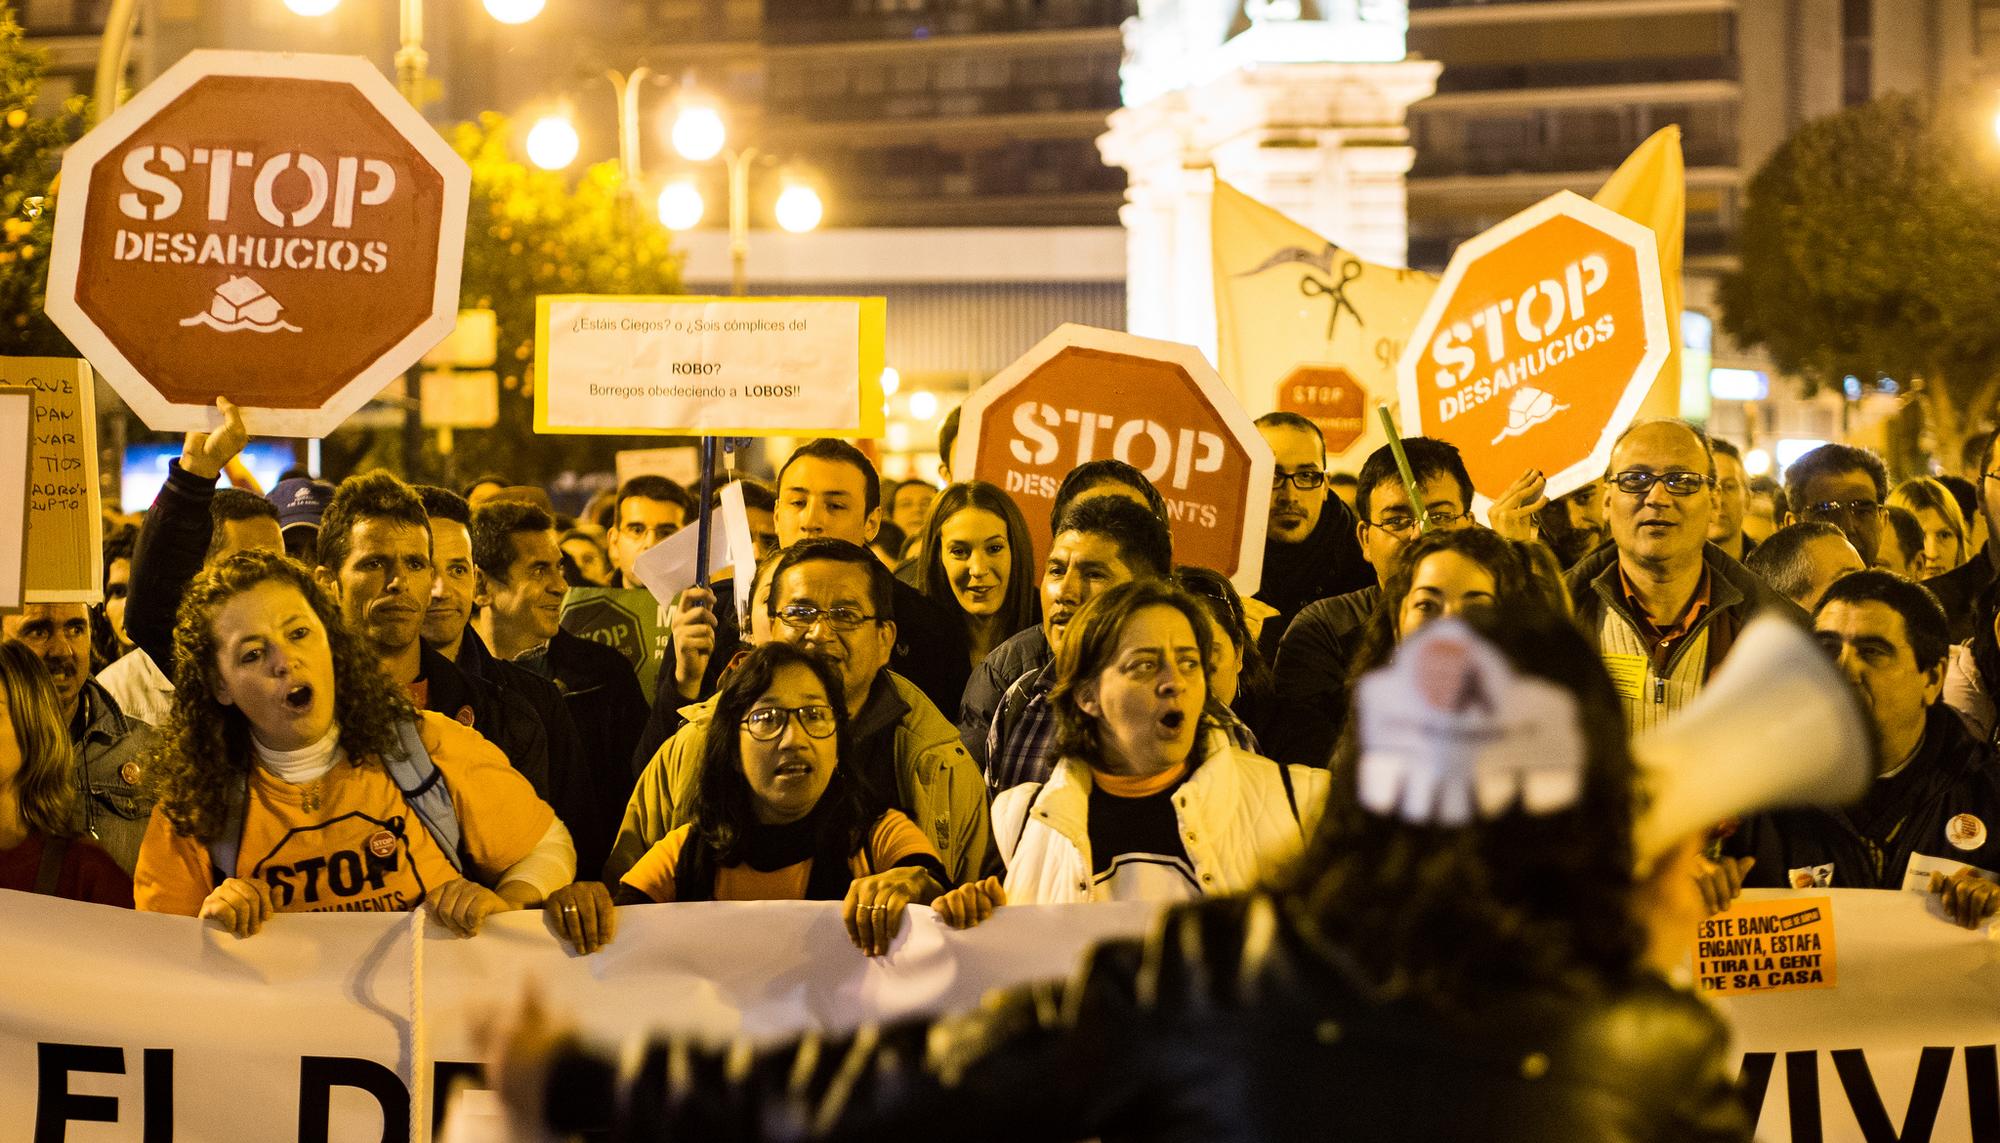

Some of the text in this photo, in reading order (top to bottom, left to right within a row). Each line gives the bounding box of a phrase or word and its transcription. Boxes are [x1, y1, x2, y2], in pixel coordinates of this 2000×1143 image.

[119, 146, 396, 228] STOP
[114, 229, 388, 273] DESAHUCIOS
[573, 318, 807, 334] ¿Estáis Ciegos? o ¿Sois cómplices del
[1432, 254, 1609, 389] STOP
[672, 363, 721, 376] ROBO?
[1439, 314, 1615, 423] DESAHUCIOS
[26, 377, 73, 394] QUE
[590, 384, 801, 399] Borregos obedeciendo a LOBOS!!
[34, 434, 76, 445] VAR
[1010, 401, 1225, 490] STOP
[266, 848, 398, 906] STOP
[1698, 919, 1733, 939] ESTE
[1738, 915, 1779, 936] BANC
[1699, 933, 1821, 958] ENGANYA, ESTAFA
[1701, 954, 1822, 974] I TIRA LA GENT
[1702, 970, 1823, 990] DE SA CASA
